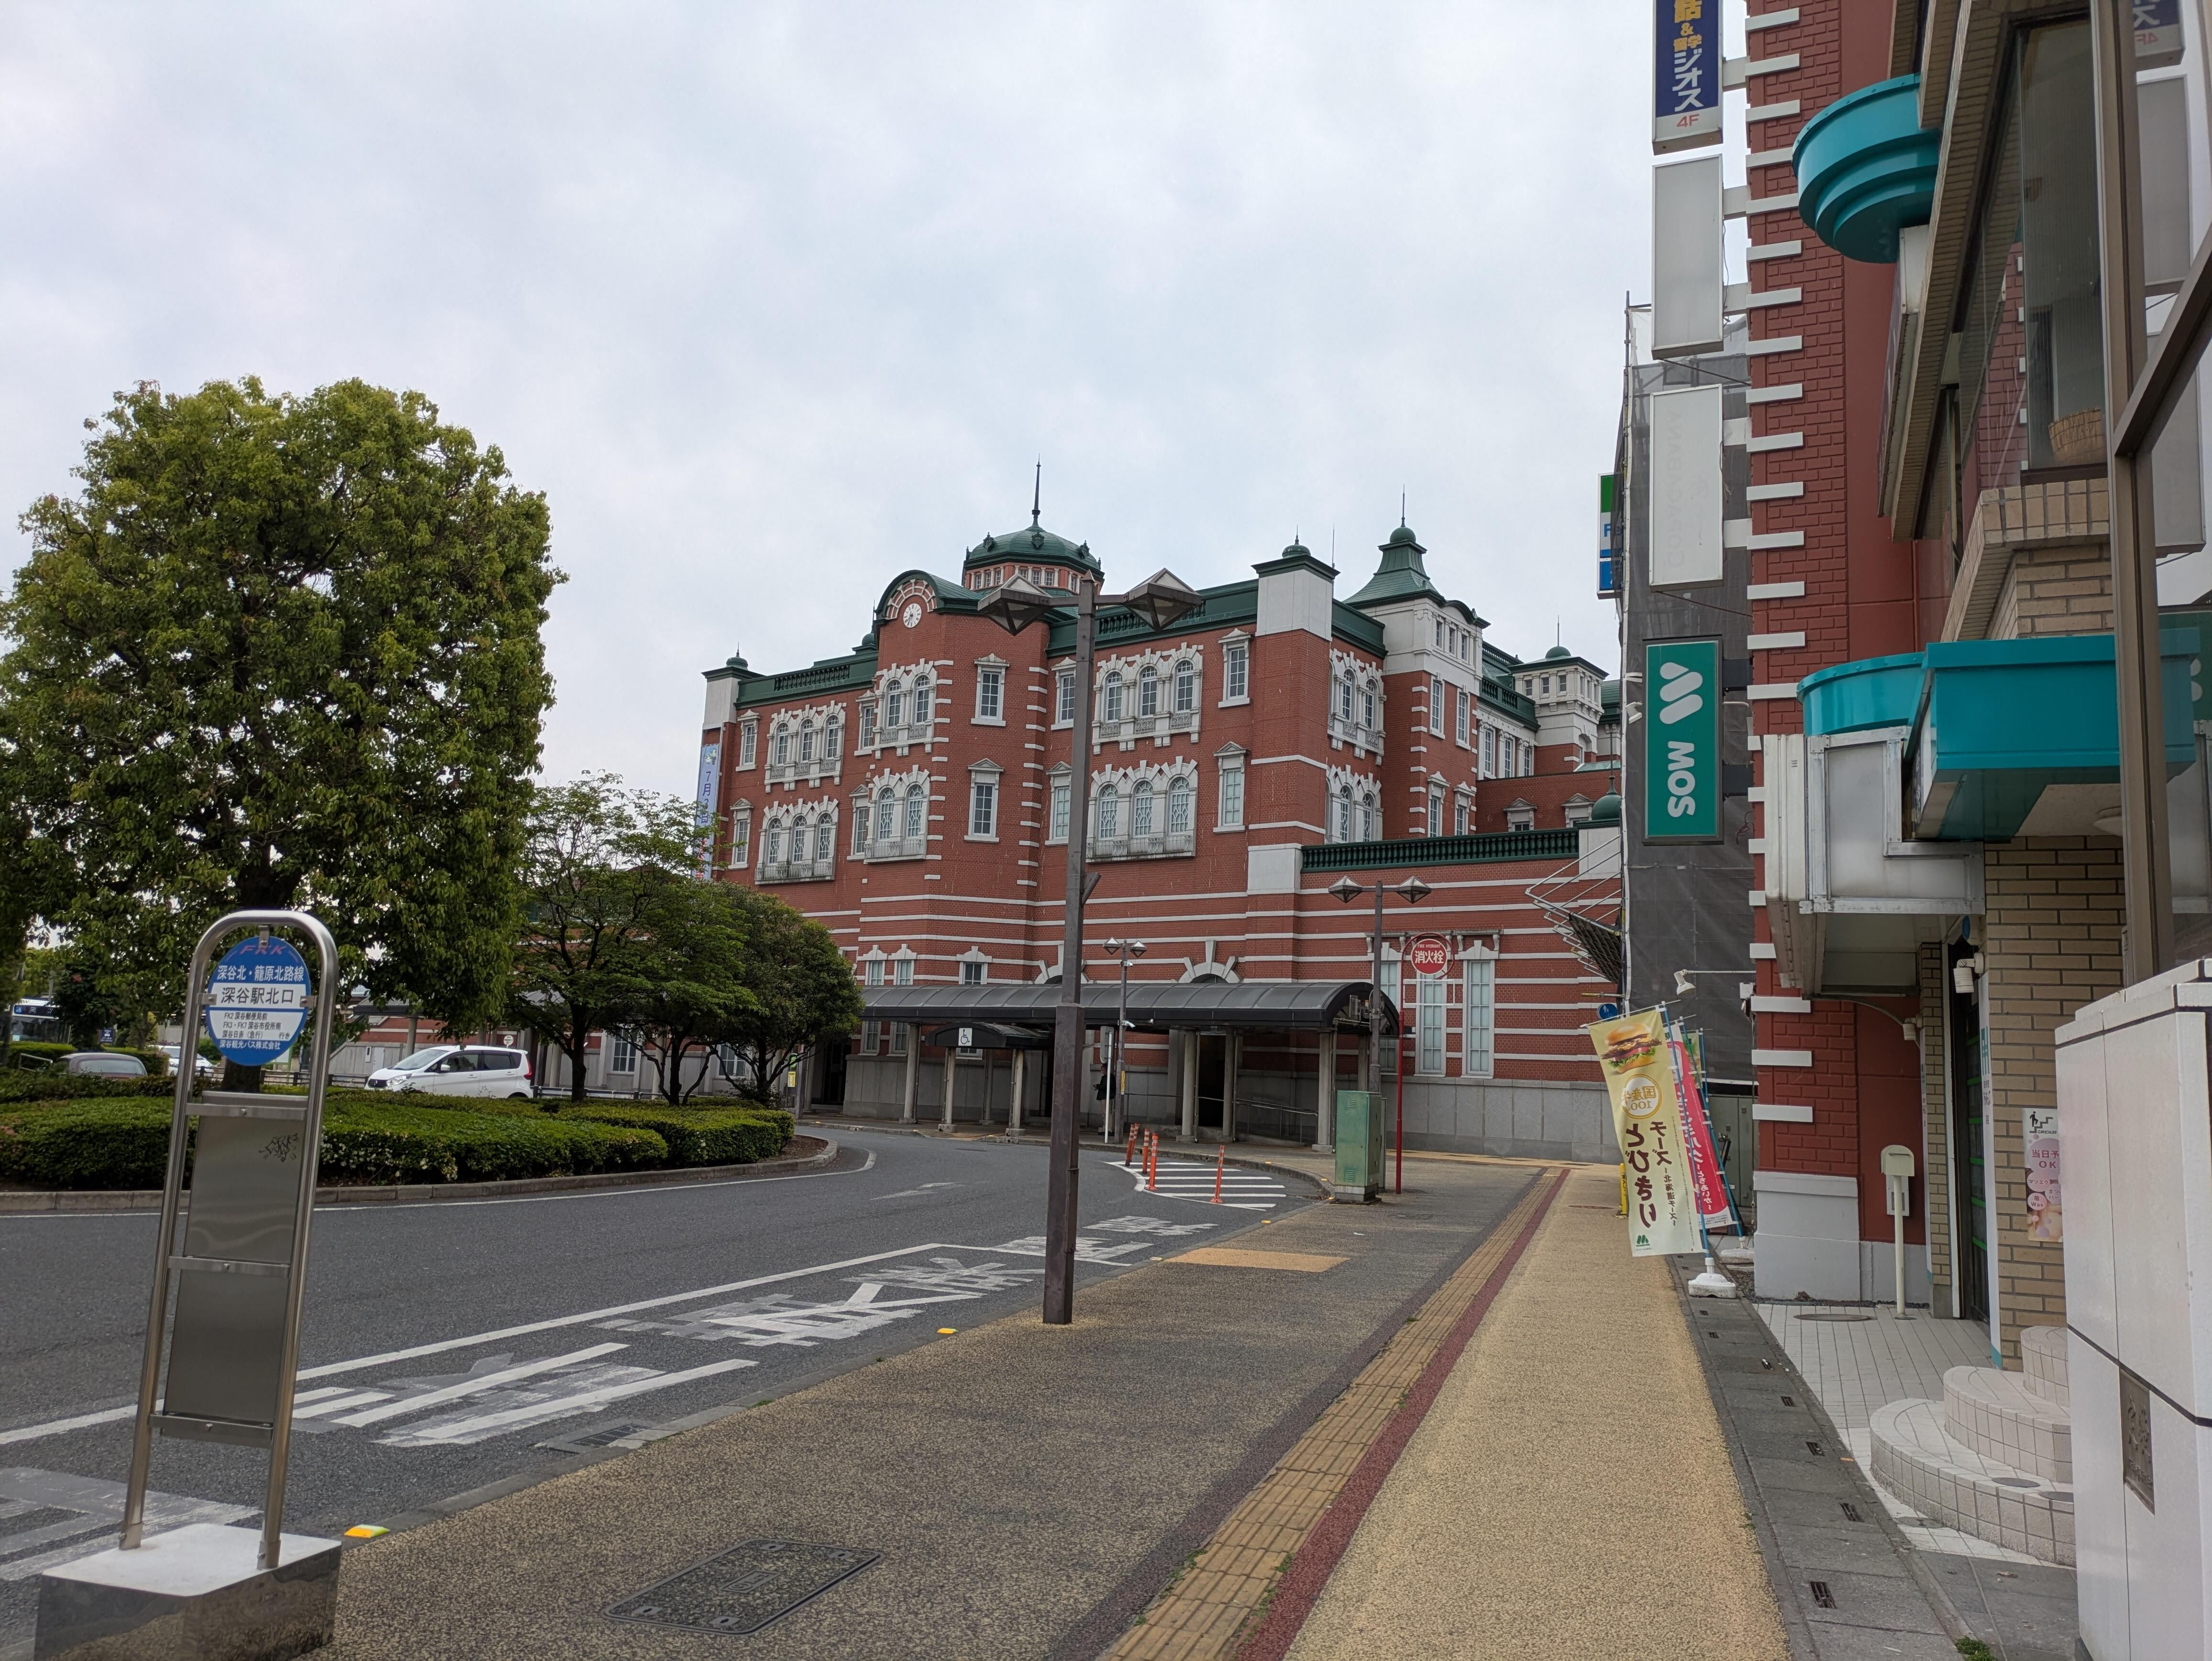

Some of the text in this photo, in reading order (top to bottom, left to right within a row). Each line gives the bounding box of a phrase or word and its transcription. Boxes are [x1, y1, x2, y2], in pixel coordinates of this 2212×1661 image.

[1676, 114, 1700, 127] 4F
[1668, 740, 1696, 818] MOS
[240, 945, 287, 955] FKK
[1415, 950, 1444, 963] 消火栓
[217, 965, 304, 981] 深谷北・籠原北路線
[221, 987, 294, 1005] 深谷駅北口
[234, 1013, 268, 1021] 深谷郵便局前
[248, 1022, 281, 1030] 深谷市役所南
[219, 1040, 281, 1050] 深谷観光バス株式会社
